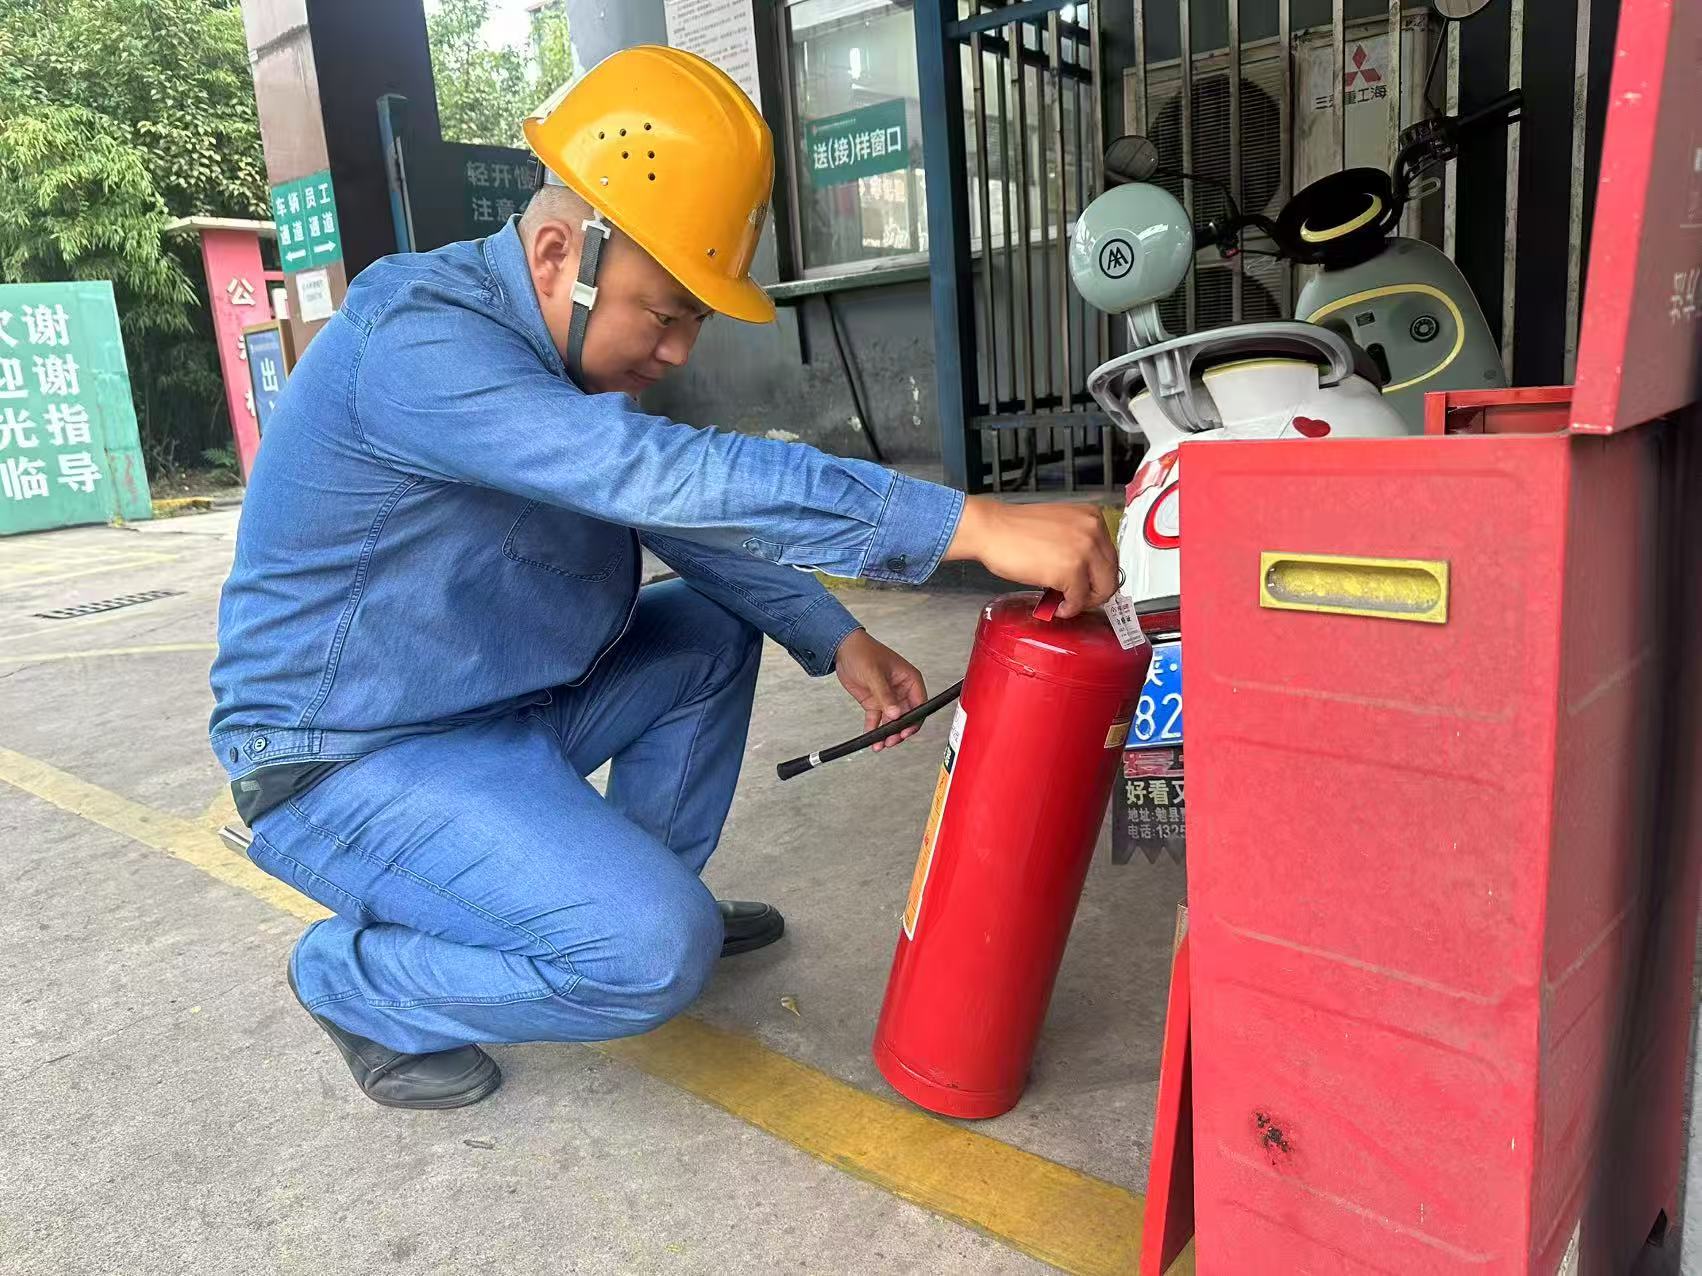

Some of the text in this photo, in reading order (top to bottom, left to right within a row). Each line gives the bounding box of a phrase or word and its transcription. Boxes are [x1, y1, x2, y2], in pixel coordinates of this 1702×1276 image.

[813, 126, 901, 169] 送(接)样窗口
[276, 191, 300, 217] 车辆
[305, 182, 331, 209] 员工
[472, 197, 530, 222] 注意
[280, 220, 305, 246] 通道
[308, 210, 335, 238] 通道
[21, 303, 103, 493] 谢谢指导
